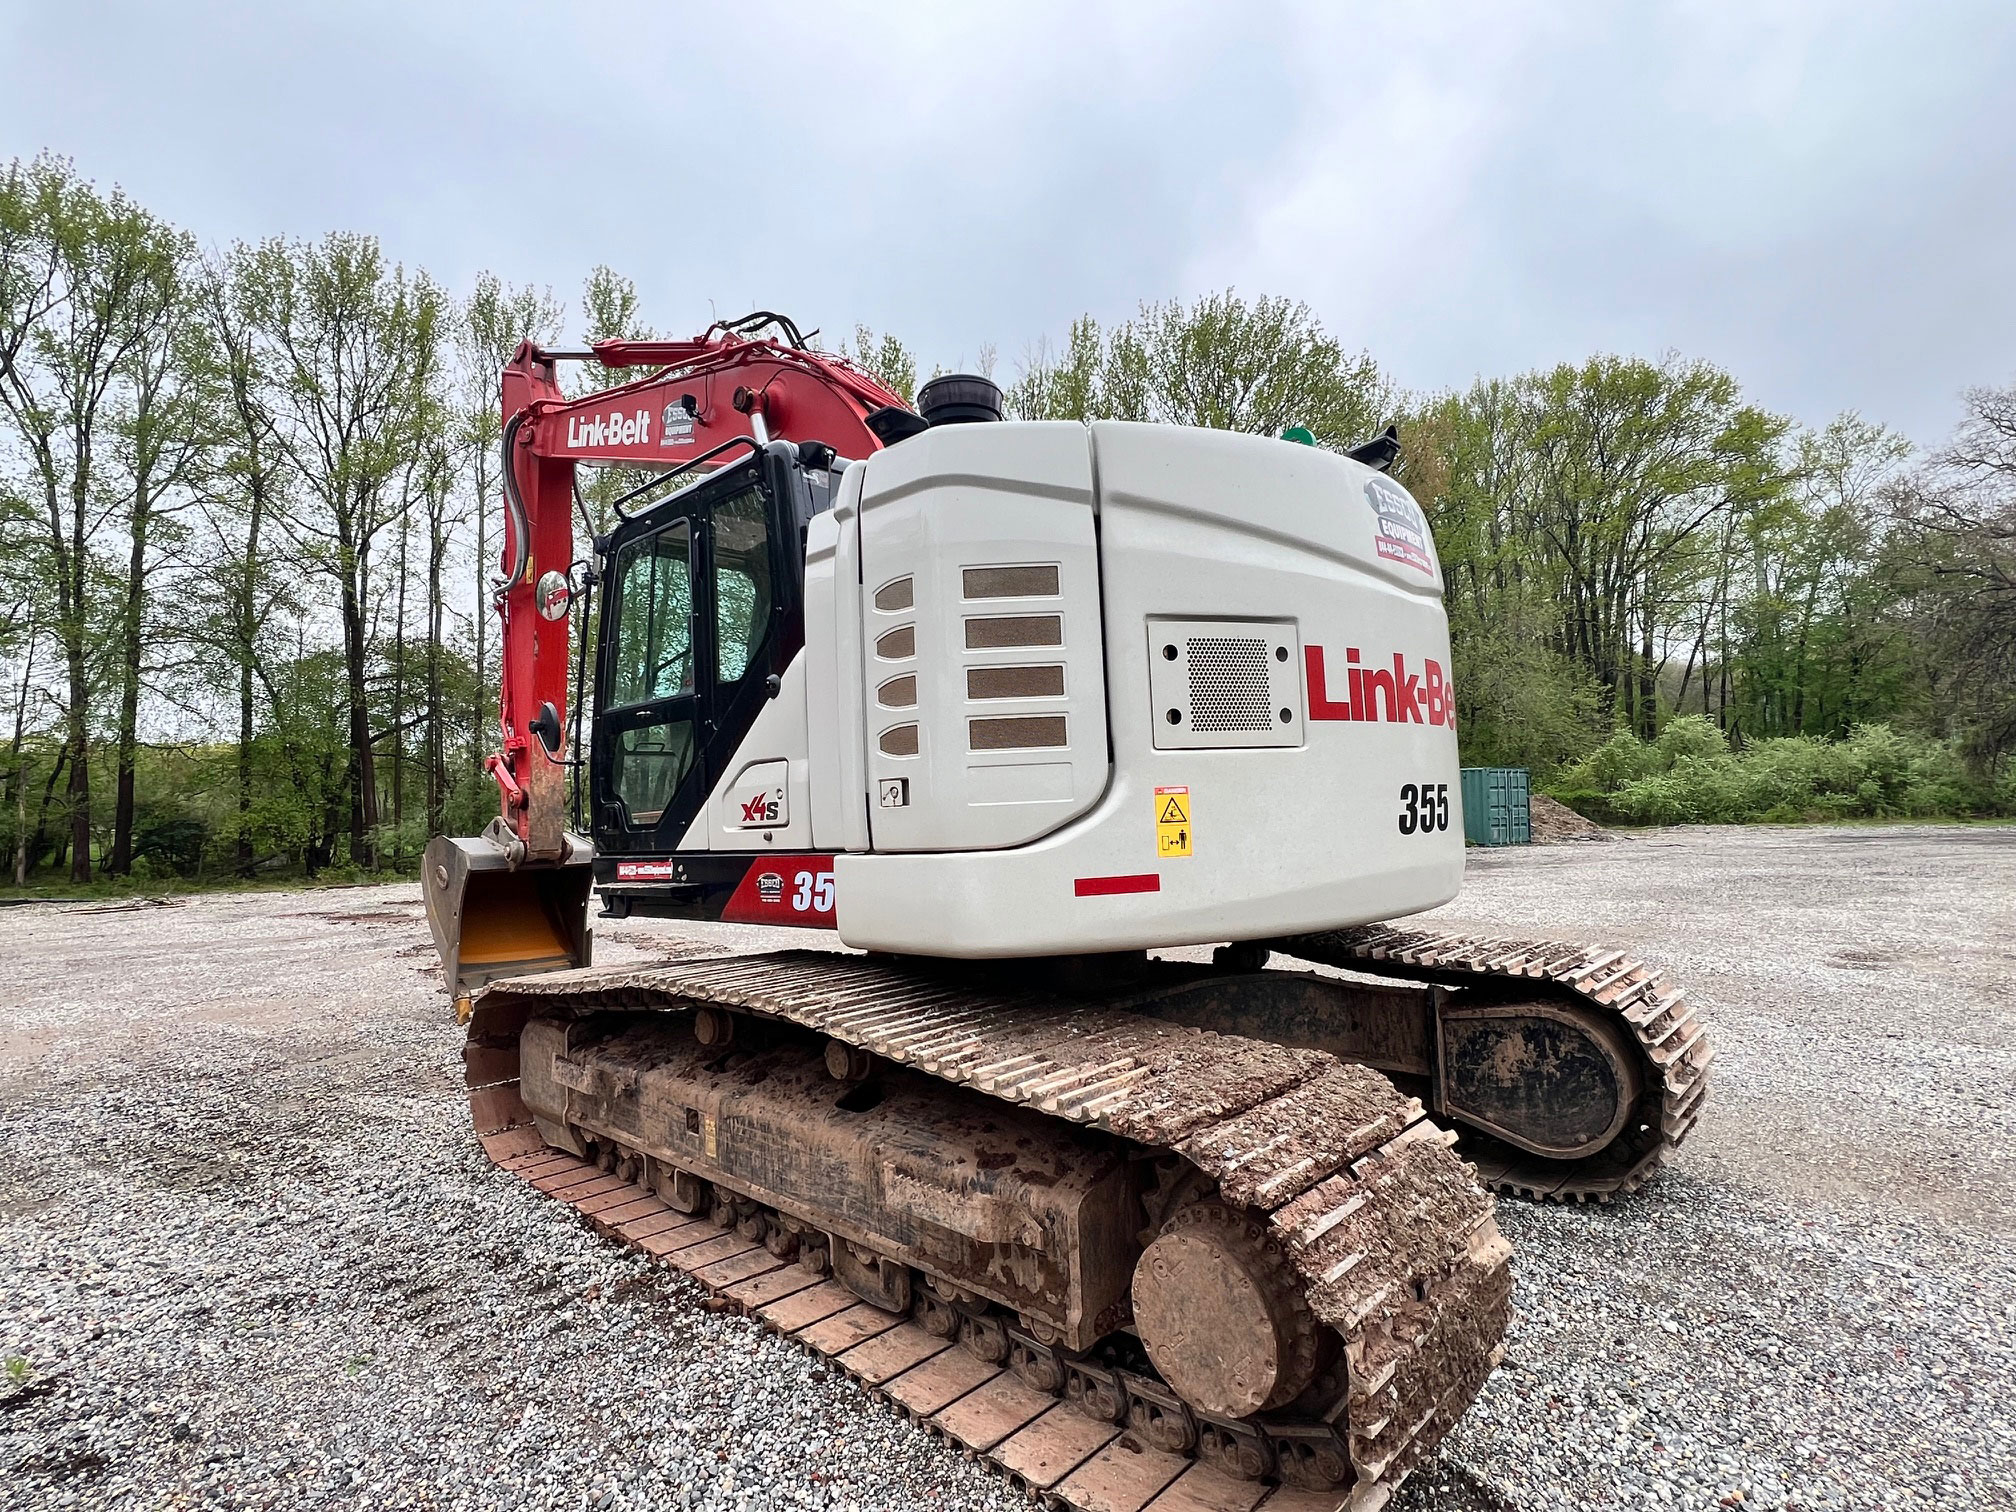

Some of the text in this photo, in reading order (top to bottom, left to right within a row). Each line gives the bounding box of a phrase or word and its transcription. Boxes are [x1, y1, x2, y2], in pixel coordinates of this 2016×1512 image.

[567, 409, 651, 448] Link-Belt
[1371, 481, 1420, 530] ESSCO
[1381, 519, 1425, 552] EQUIPMENT
[1303, 644, 1457, 731] Link-Be
[740, 791, 779, 822] X4S
[1398, 783, 1449, 835] 355
